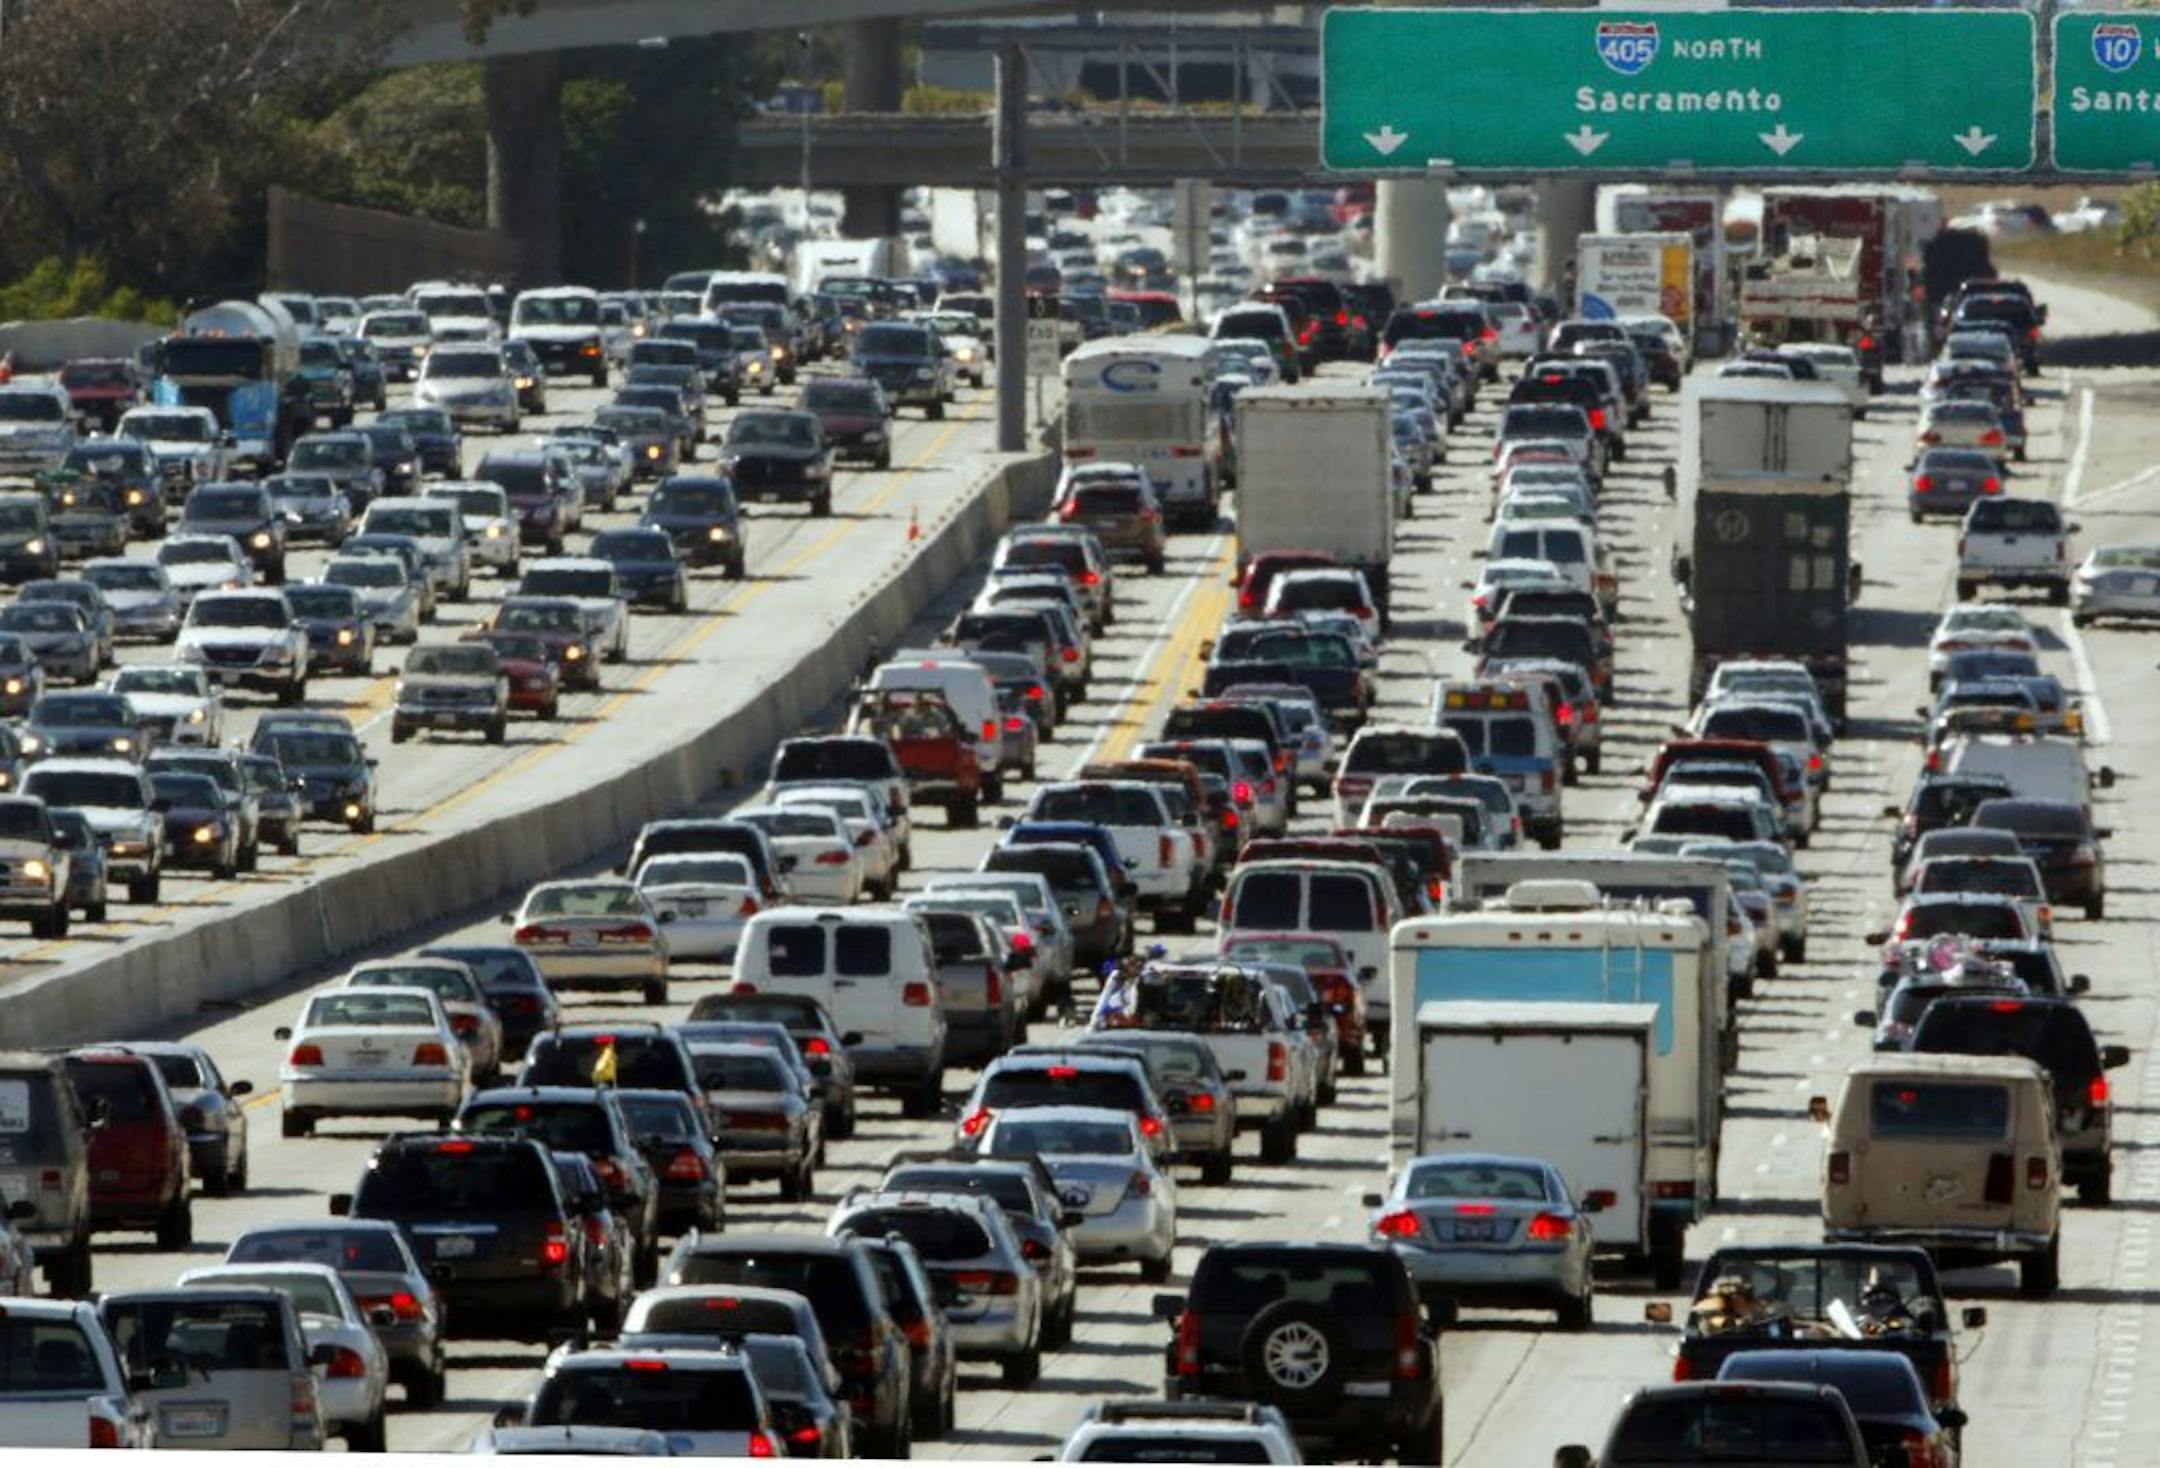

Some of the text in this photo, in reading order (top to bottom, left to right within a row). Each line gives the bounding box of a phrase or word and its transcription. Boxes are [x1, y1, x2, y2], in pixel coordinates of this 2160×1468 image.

[1604, 37, 1762, 62] 405 NORTH
[2104, 38, 2131, 62] 10
[1576, 86, 1781, 112] Sacramento
